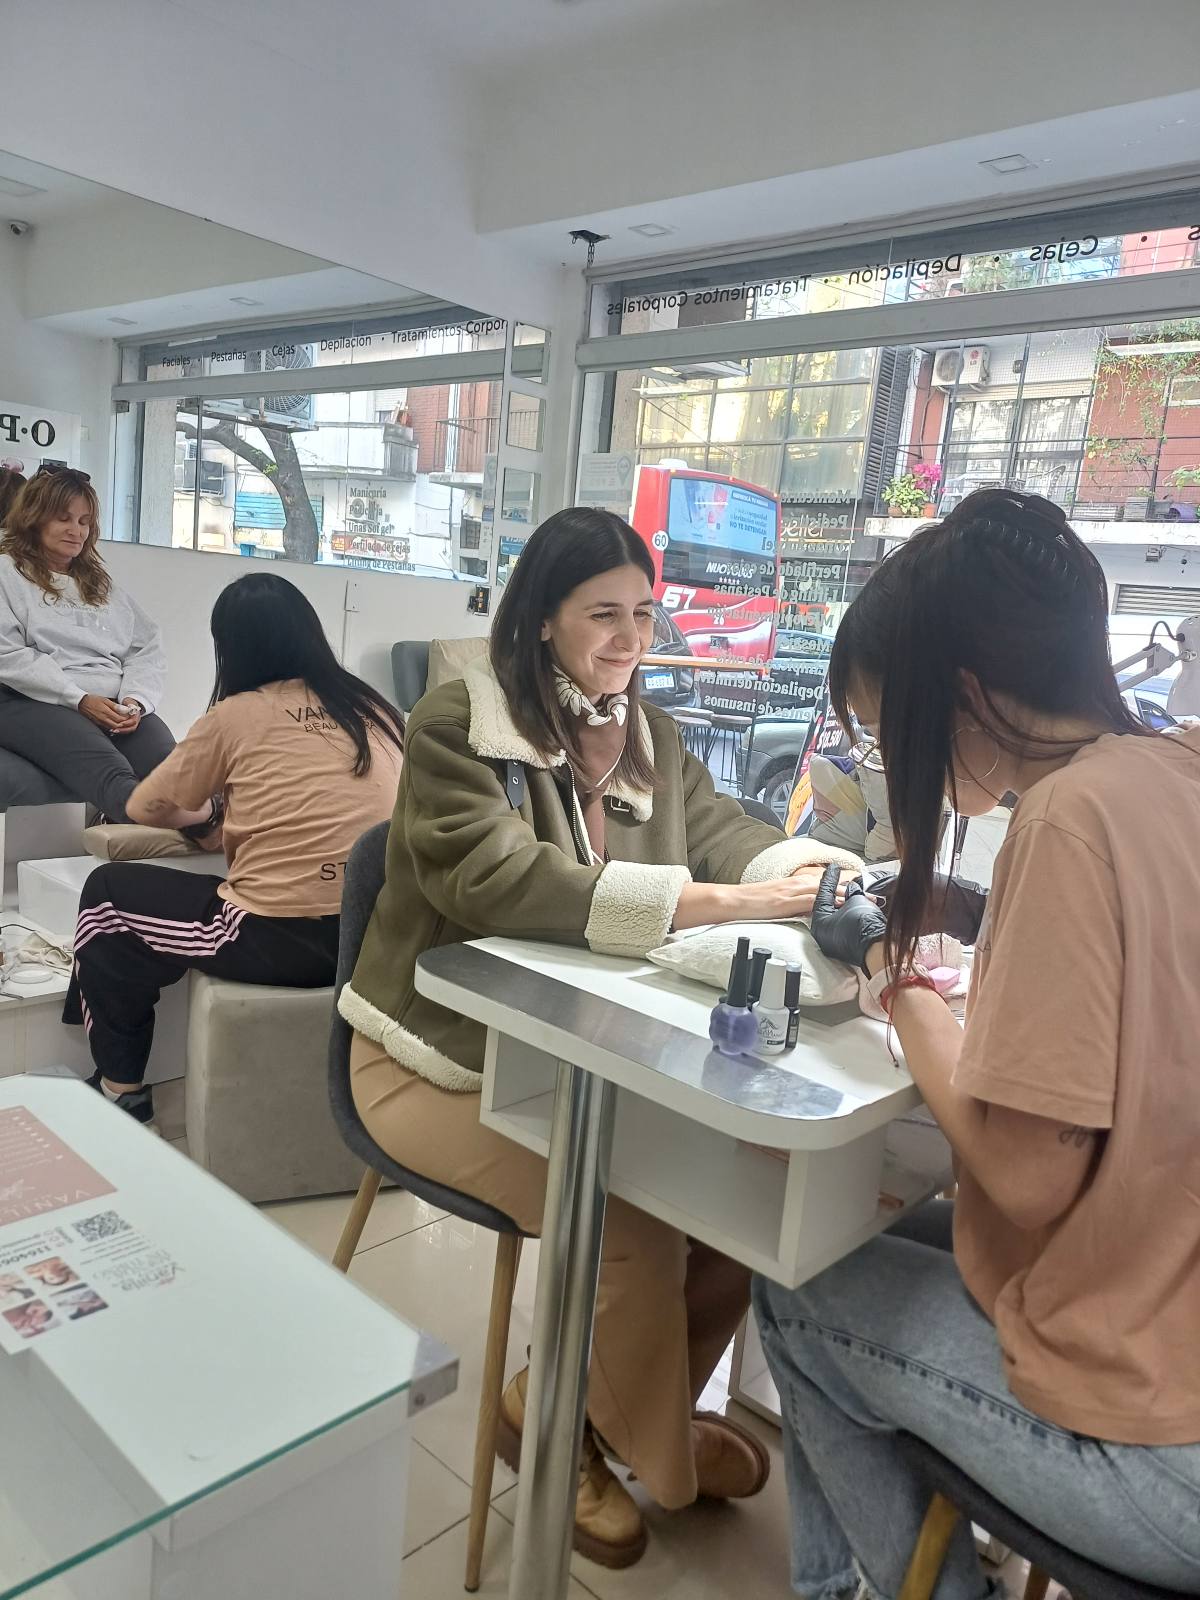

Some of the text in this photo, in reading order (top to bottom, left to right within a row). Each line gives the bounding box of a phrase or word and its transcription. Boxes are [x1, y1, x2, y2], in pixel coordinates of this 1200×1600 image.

[162, 355, 191, 367] Faciales
[272, 343, 295, 359] Cejas
[392, 325, 462, 343] Tratamientos
[653, 533, 668, 547] 60
